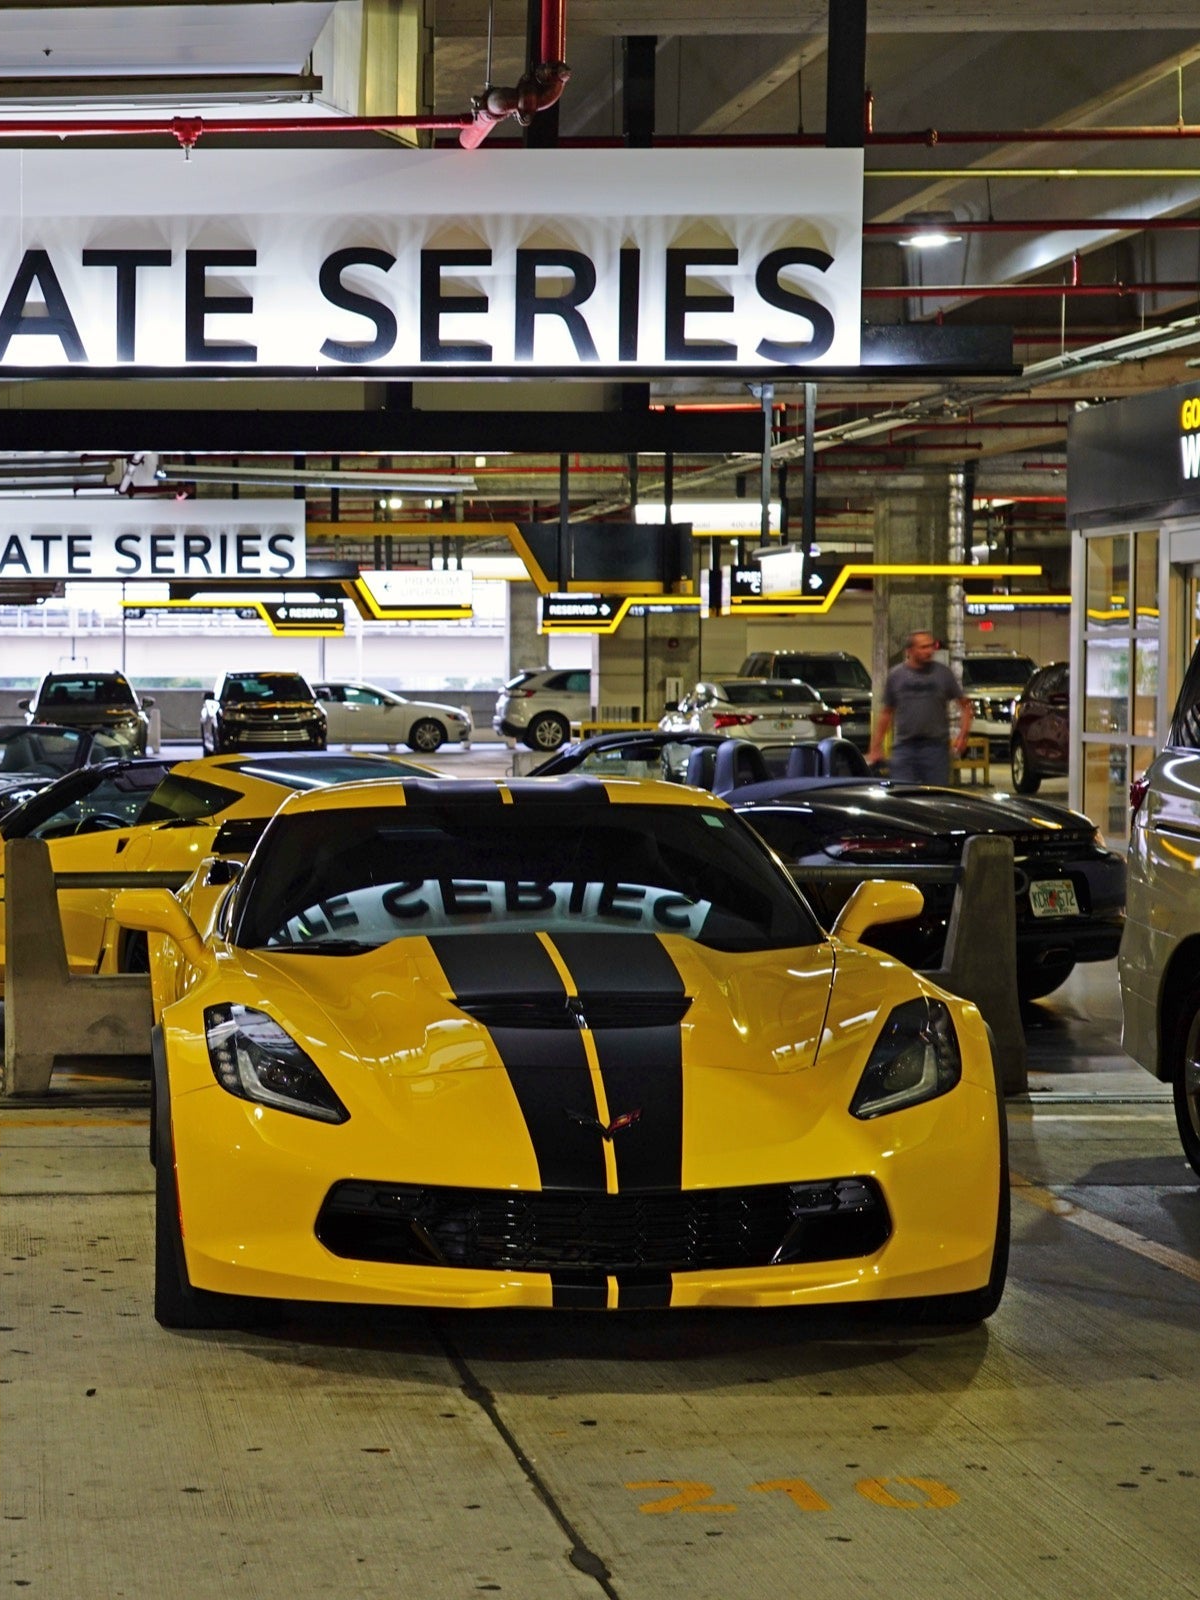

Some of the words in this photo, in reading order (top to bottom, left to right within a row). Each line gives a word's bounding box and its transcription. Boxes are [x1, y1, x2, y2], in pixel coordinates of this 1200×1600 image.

[318, 247, 836, 364] SERIES
[113, 533, 297, 575] SERIES
[289, 607, 338, 619] RESERVED
[548, 604, 598, 615] RESERVED
[625, 1476, 961, 1513] 210
